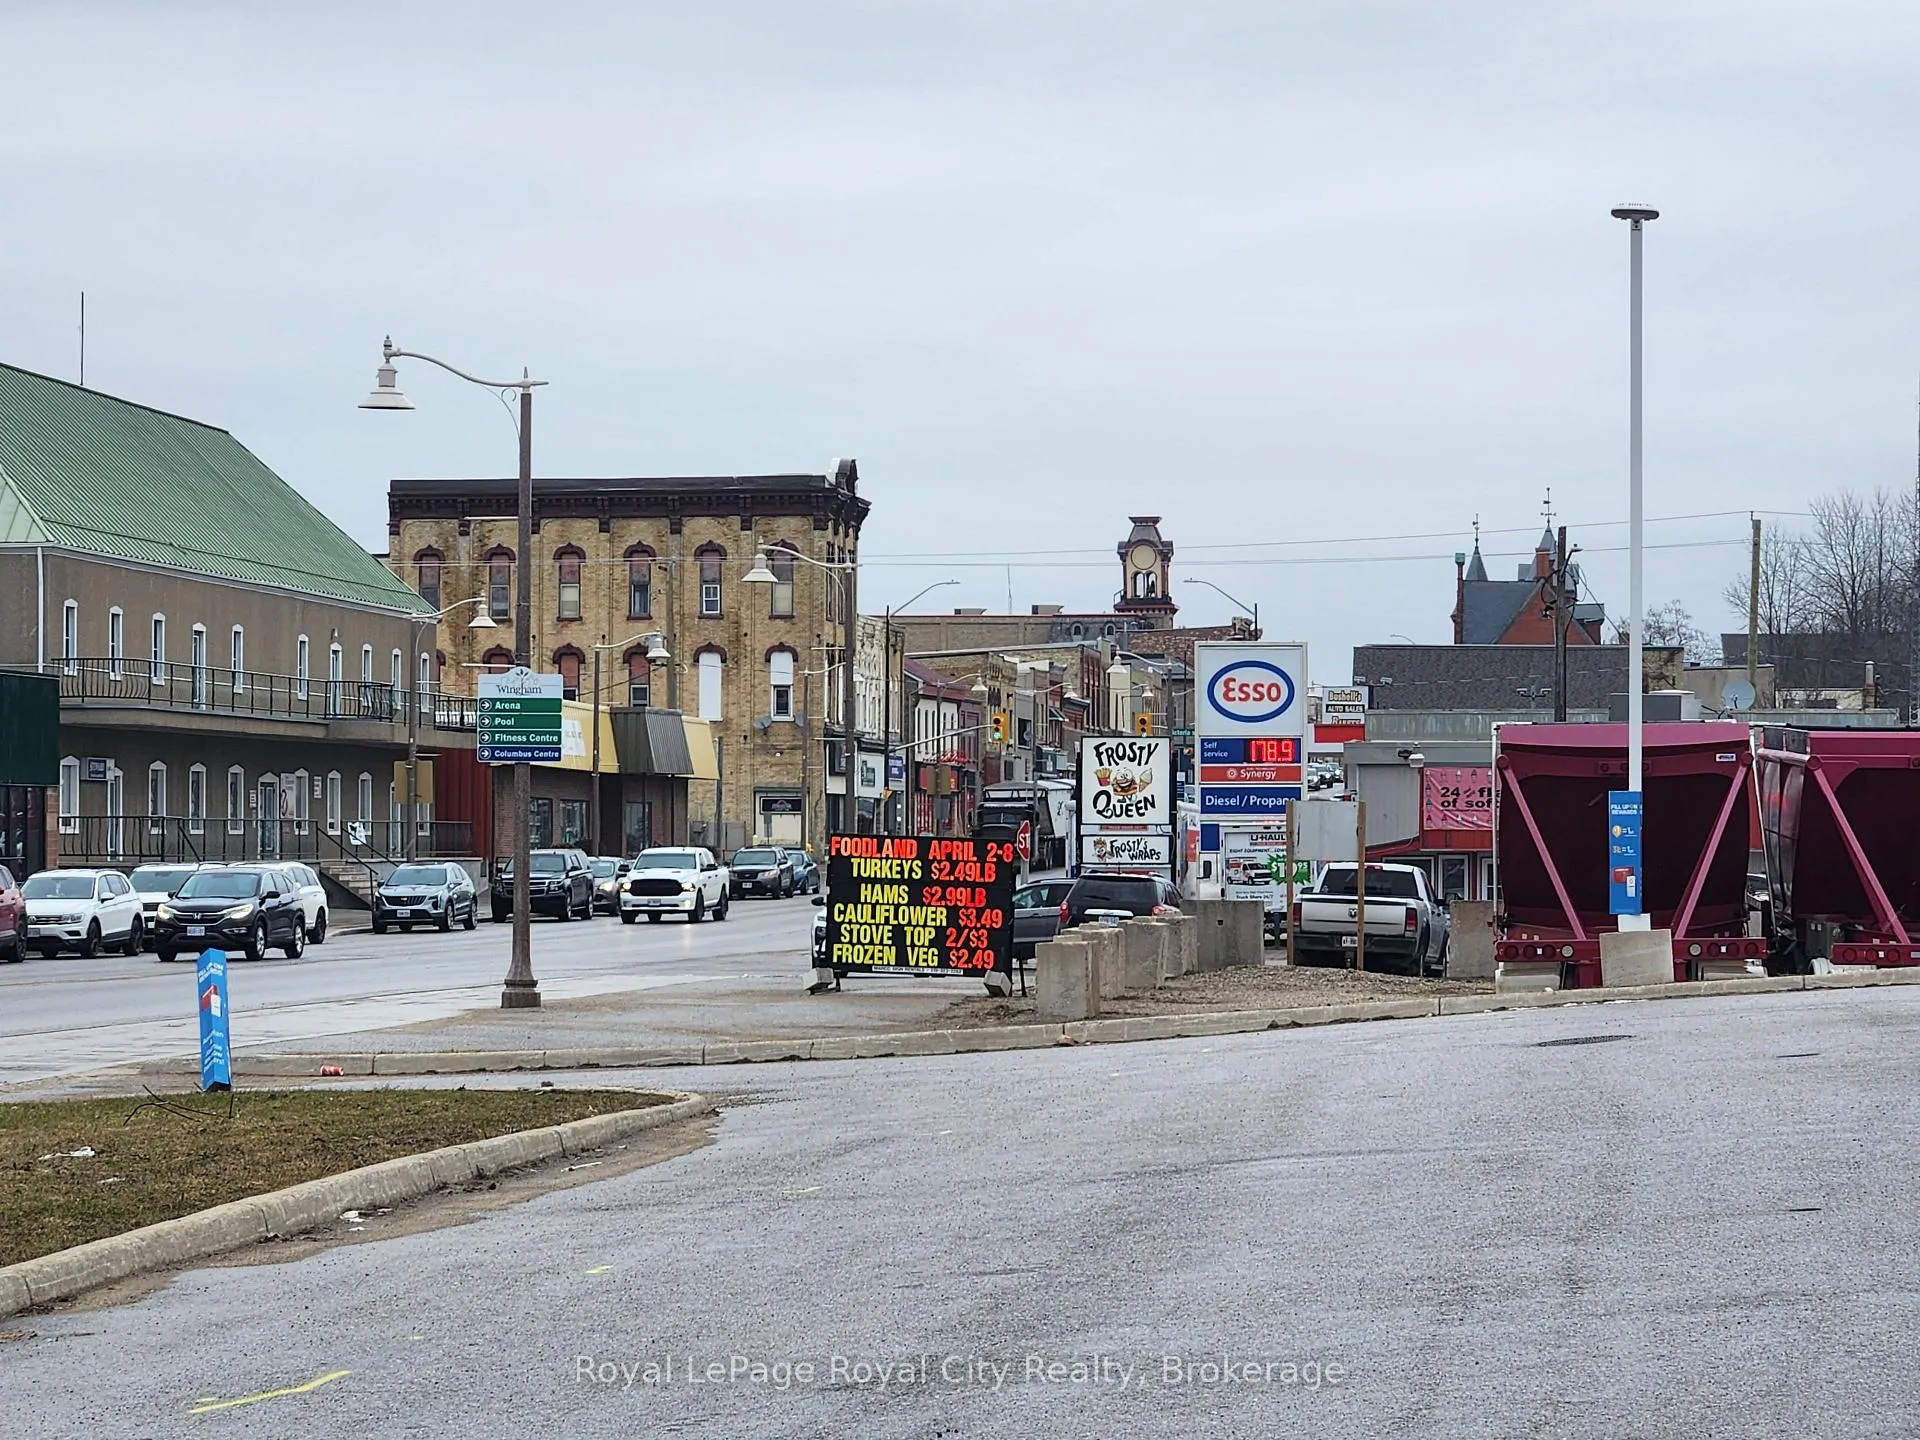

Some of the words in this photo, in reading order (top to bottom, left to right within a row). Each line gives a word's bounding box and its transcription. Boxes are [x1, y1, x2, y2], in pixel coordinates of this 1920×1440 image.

[496, 684, 542, 696] Wingham
[1222, 677, 1282, 702] Esso
[494, 701, 521, 710] Arena
[494, 717, 515, 726] Pool
[494, 733, 527, 742] Fitness
[529, 733, 559, 743] Centre
[1203, 741, 1218, 749] Self
[1251, 740, 1293, 762] 178.9
[494, 749, 532, 758] Columbus
[533, 749, 560, 758] Centre
[1093, 741, 1160, 767] FROSTY
[1203, 750, 1229, 758] service
[1240, 769, 1277, 780] Synergy
[1440, 786, 1460, 798] 24
[1092, 790, 1157, 820] QUEEN
[1205, 794, 1240, 806] Diesel
[1241, 794, 1248, 807] /
[1440, 798, 1458, 808] of
[830, 836, 918, 859] FOODLAND
[928, 839, 977, 862] APRIL
[986, 842, 1014, 863] 2-8
[1128, 848, 1162, 861] WRAPS
[851, 857, 922, 880] TURKEYS
[931, 861, 996, 883] $2.49LB
[860, 883, 909, 905] HAMS
[922, 886, 986, 908] $2.99LB
[833, 903, 947, 927] CAULIFLOWER
[958, 908, 1003, 929] $3.49
[840, 923, 893, 945] STOVE
[904, 925, 936, 947] TOP
[946, 928, 988, 949] 2/$3
[832, 943, 896, 966] FROZEN
[907, 947, 939, 967] VEG
[949, 949, 995, 970] $2.49
